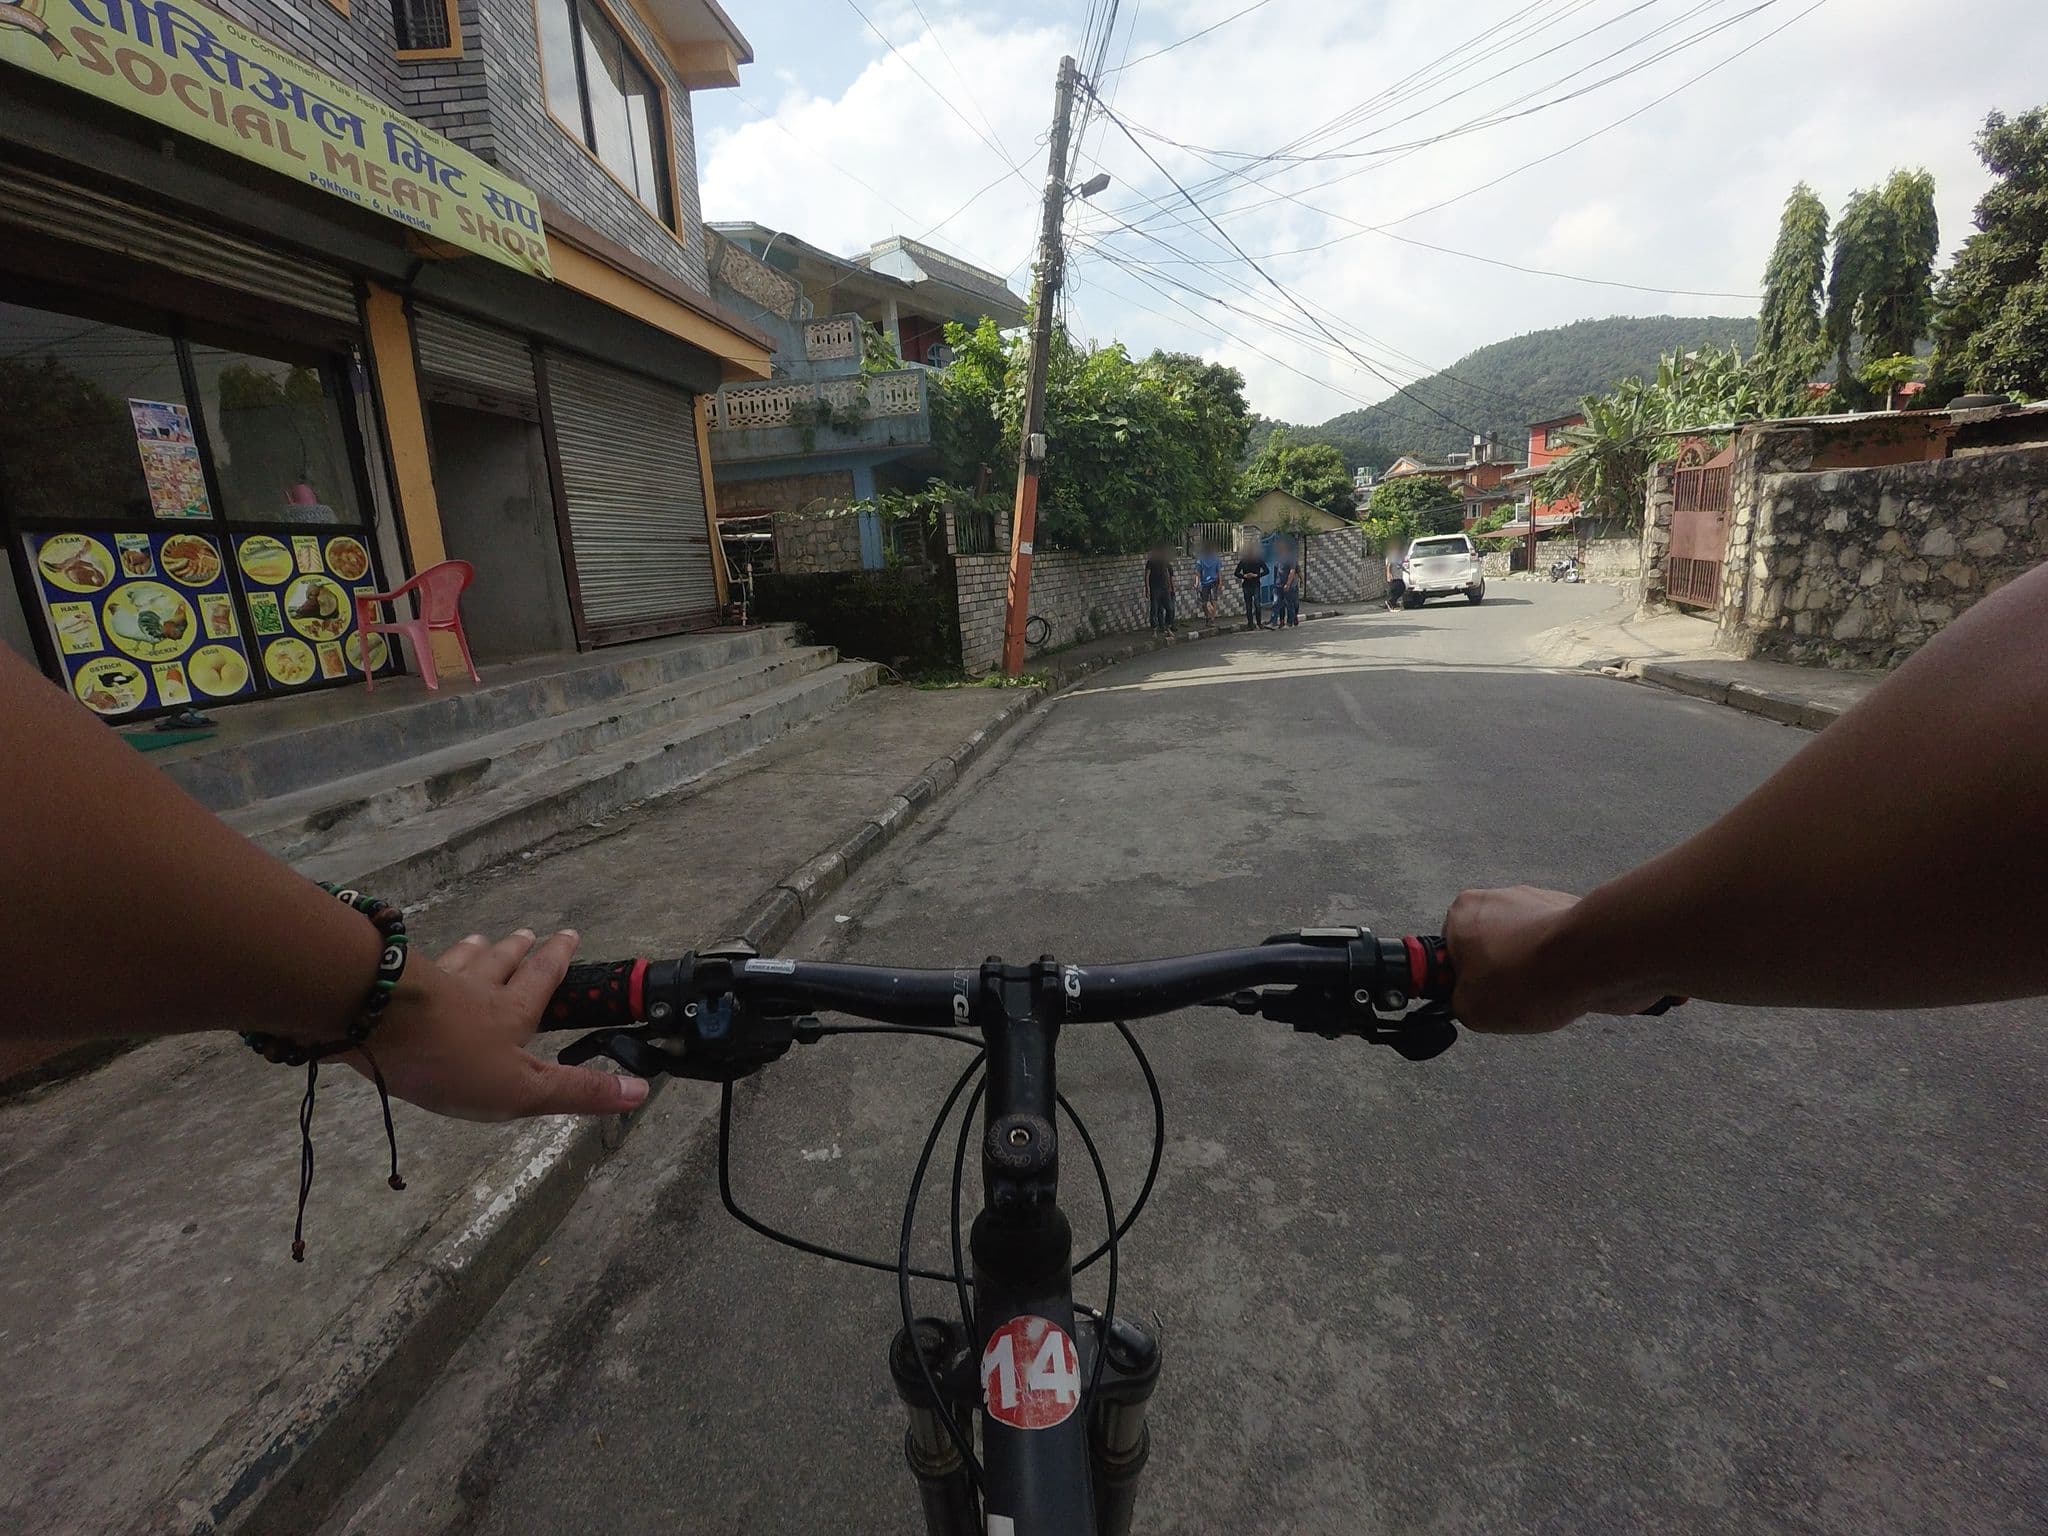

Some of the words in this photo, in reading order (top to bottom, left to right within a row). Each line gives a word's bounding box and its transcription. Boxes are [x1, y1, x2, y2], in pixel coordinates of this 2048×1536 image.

[226, 24, 248, 42] Our
[250, 38, 321, 82] Commitment
[70, 26, 306, 161] SOCIAL
[321, 140, 443, 220] MEAT
[455, 204, 547, 260] SHOP
[383, 121, 467, 198] मिट
[386, 203, 432, 232] Lakeside
[55, 536, 81, 545] STEAK
[60, 604, 80, 613] HAM
[201, 648, 220, 656] EGGS
[89, 661, 122, 674] OSTRICH
[983, 1330, 1076, 1410] 14
